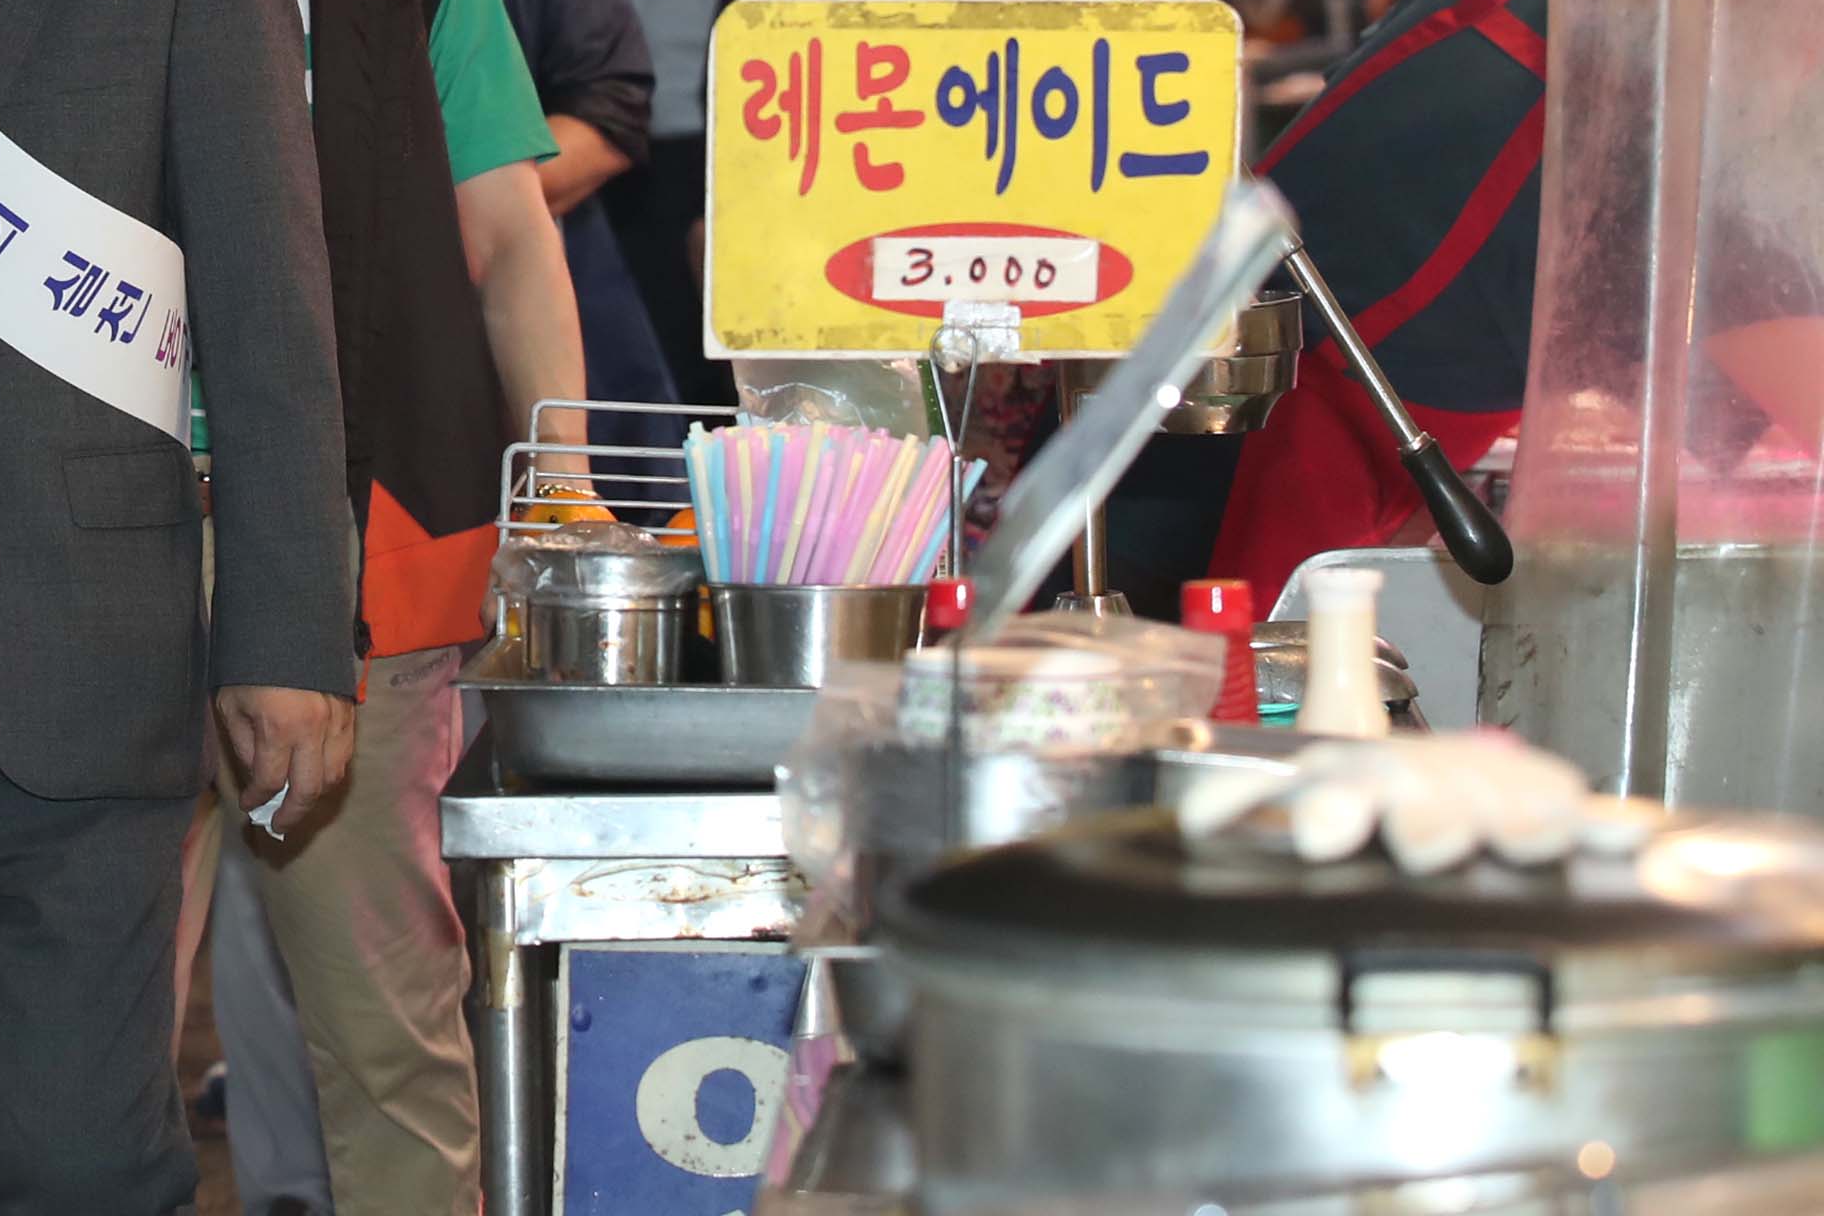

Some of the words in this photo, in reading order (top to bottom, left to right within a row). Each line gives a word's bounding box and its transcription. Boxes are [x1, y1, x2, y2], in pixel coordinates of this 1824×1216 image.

[740, 37, 1210, 196] 레몬에이드
[43, 250, 153, 344] 실천
[900, 248, 1057, 288] 3.000
